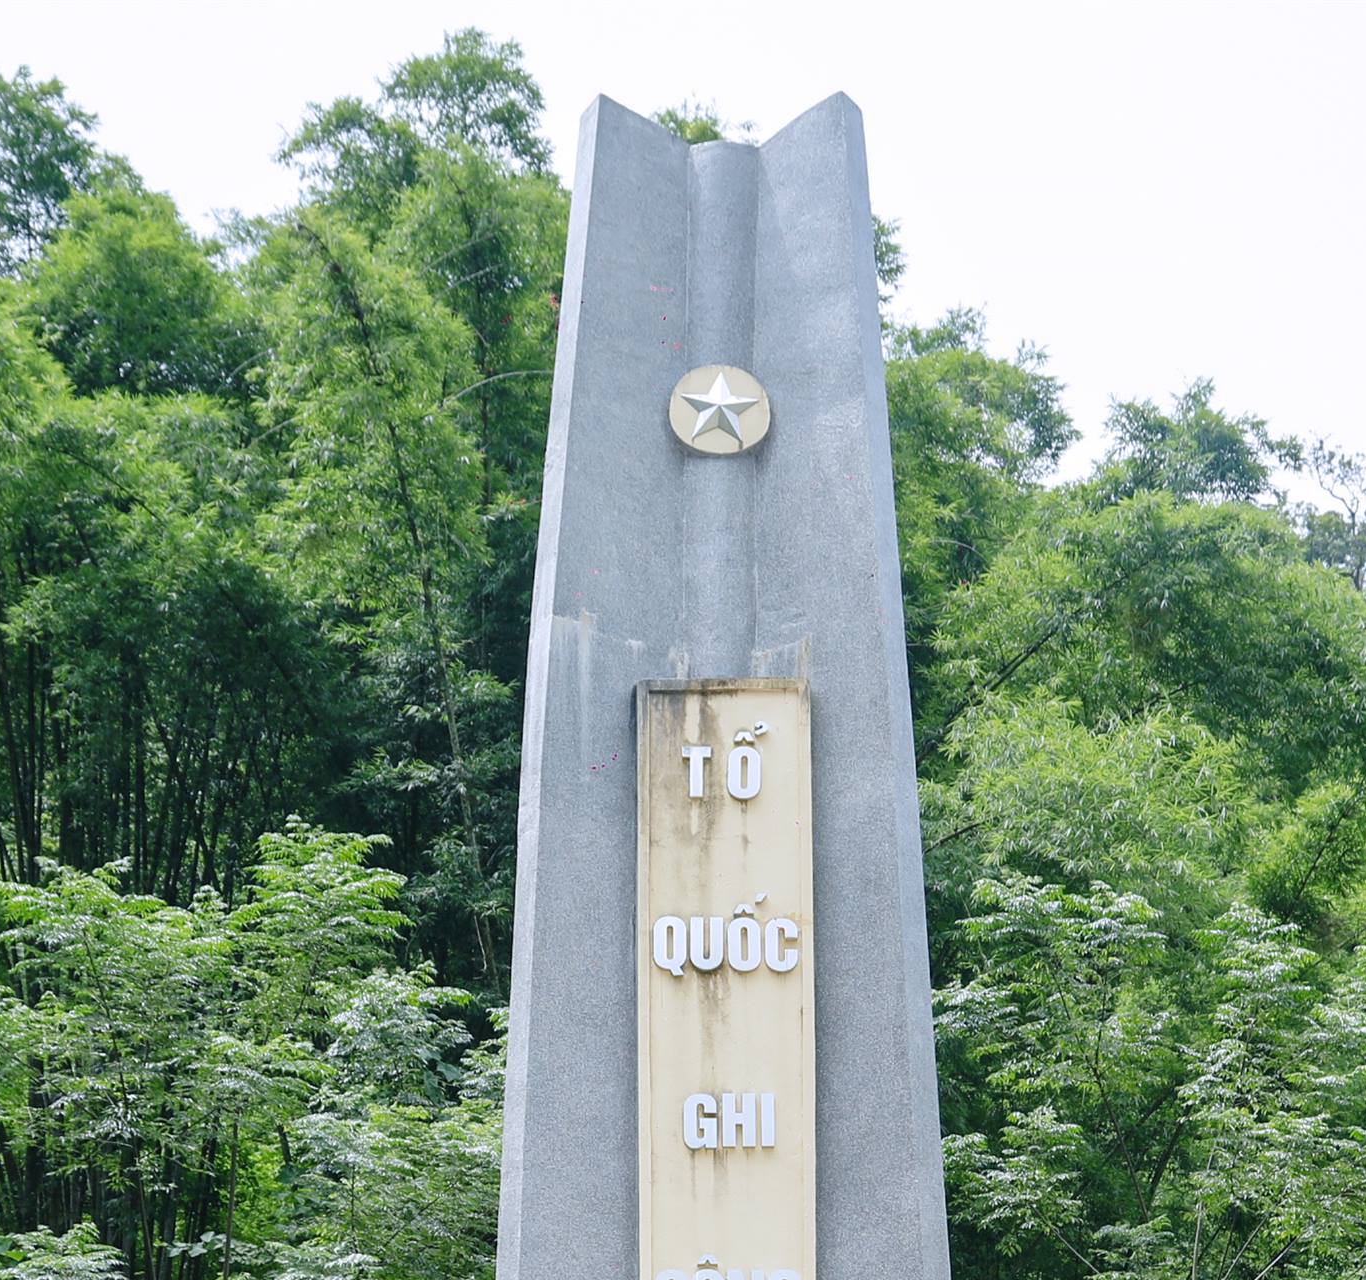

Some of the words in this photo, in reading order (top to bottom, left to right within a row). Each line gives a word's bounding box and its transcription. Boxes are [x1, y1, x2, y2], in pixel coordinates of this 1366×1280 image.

[681, 720, 771, 800] TỔ
[652, 890, 801, 977] QUỐC
[683, 1091, 777, 1150] GHI
